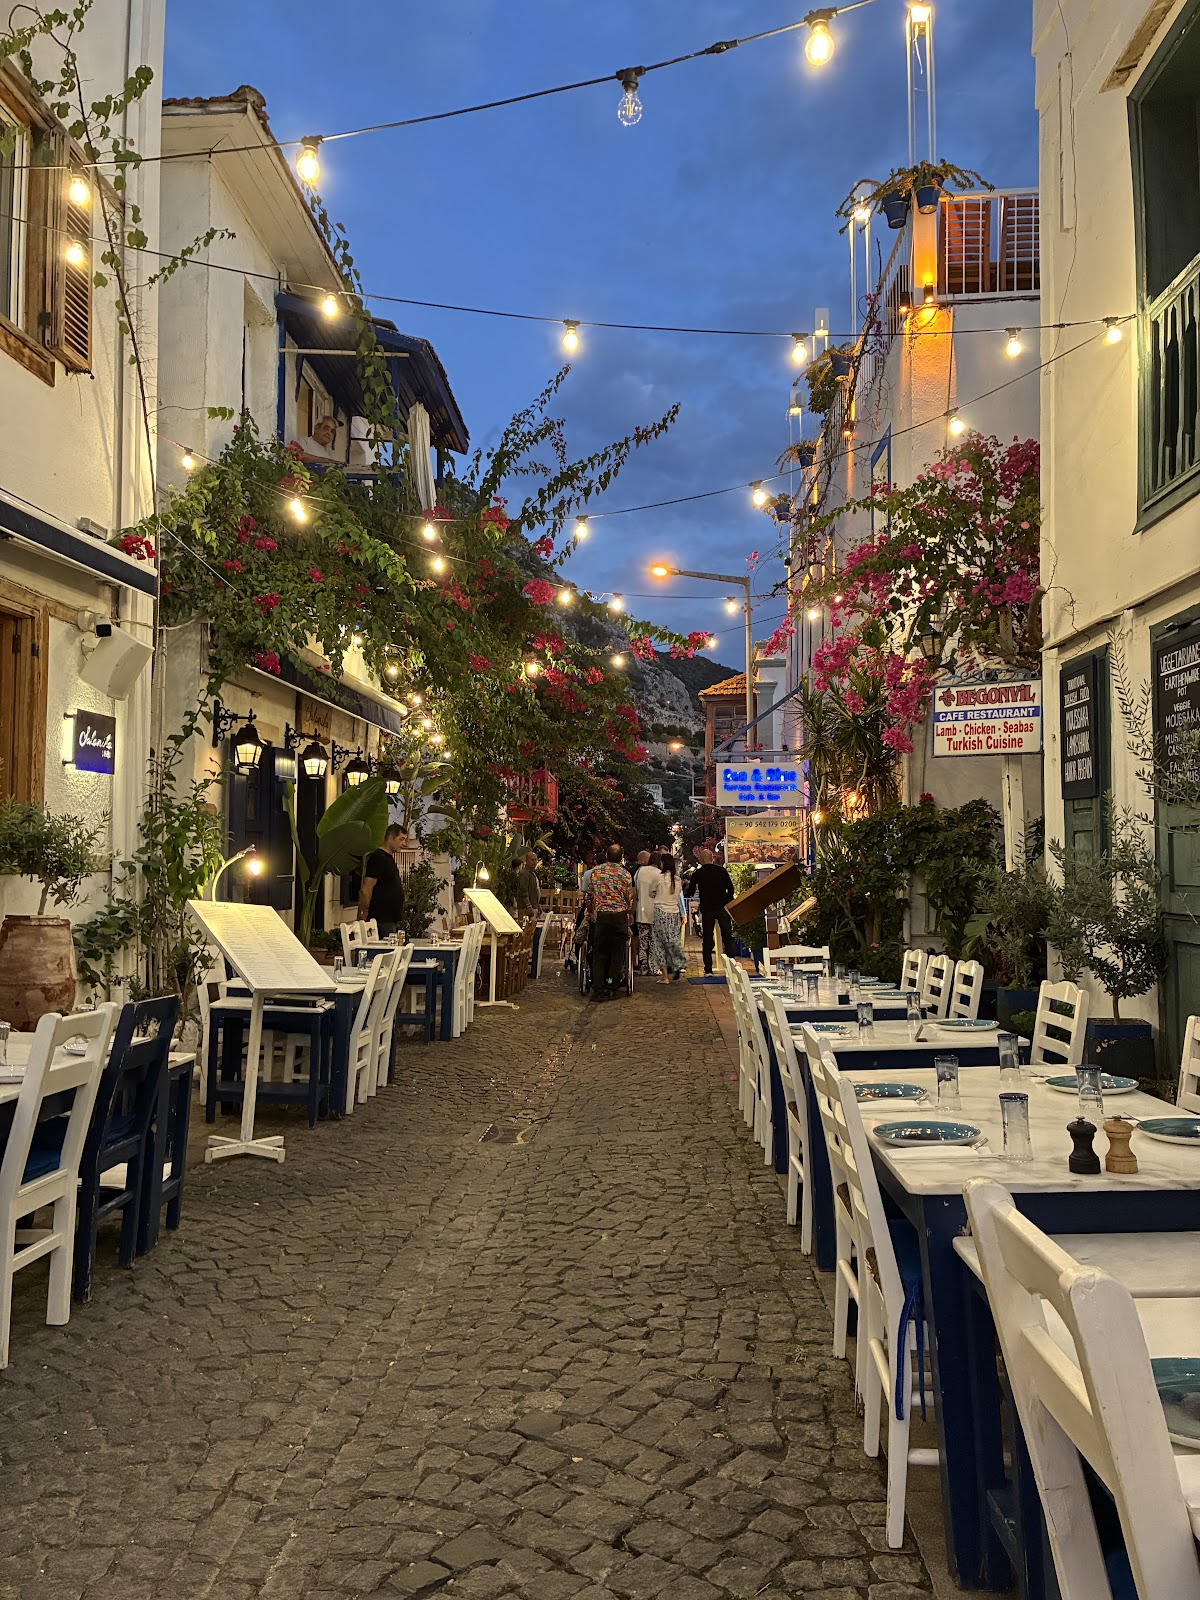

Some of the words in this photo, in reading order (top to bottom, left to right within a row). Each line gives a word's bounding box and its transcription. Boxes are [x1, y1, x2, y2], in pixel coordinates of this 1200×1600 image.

[1177, 686, 1188, 697] POT
[1173, 700, 1191, 712] VEGGIE
[939, 712, 964, 721] CAFE
[967, 708, 1035, 720] RESTAURANT
[935, 724, 957, 736] Lamb
[964, 722, 996, 735] Chicken
[1003, 720, 1034, 733] Seabas
[947, 736, 983, 751] Turkish
[986, 734, 1023, 749] Cuisine
